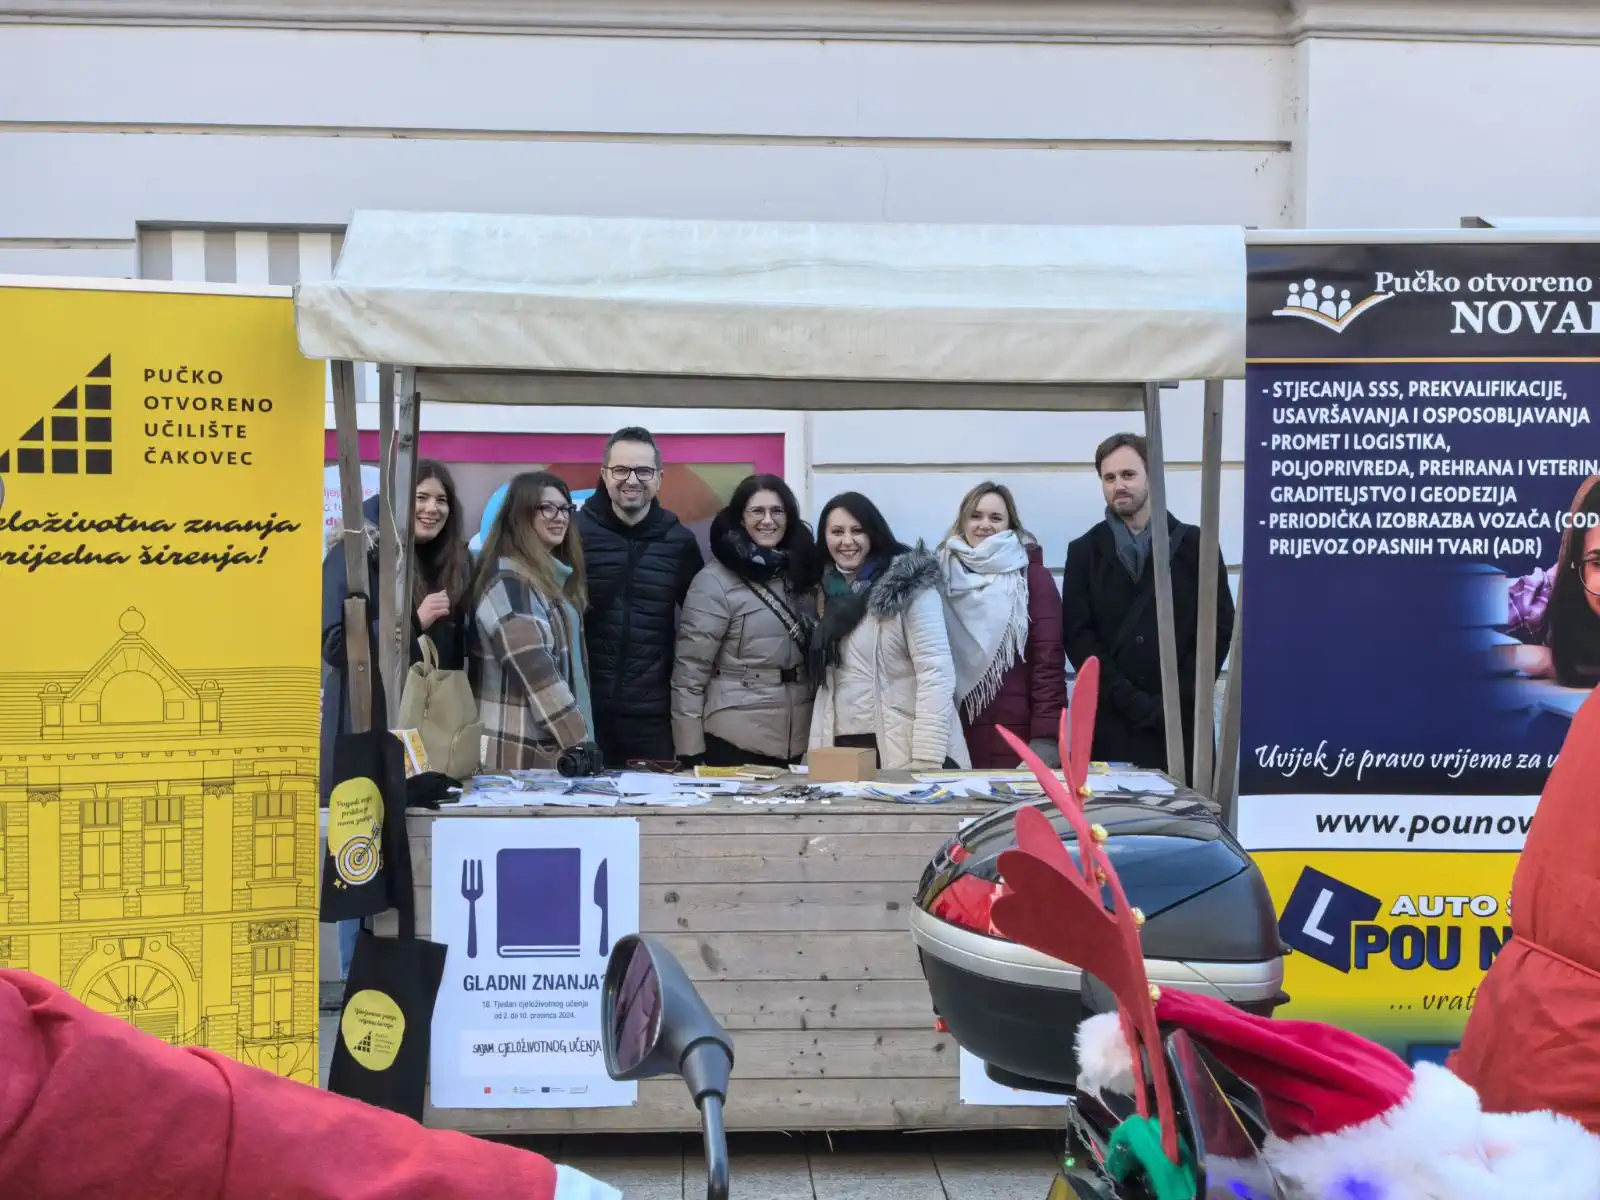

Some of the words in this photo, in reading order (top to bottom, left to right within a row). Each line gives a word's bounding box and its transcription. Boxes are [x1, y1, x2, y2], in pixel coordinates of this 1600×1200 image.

[1375, 270, 1460, 293] Pučko
[1468, 273, 1593, 293] otvoreno
[144, 366, 223, 384] PUČKO
[1273, 381, 1364, 401] STJECANJA
[1368, 381, 1403, 400] SSS,
[1408, 380, 1567, 401] PREKVALIFIKACIJE,
[144, 396, 273, 412] OTVORENO
[1272, 404, 1409, 426] USAVRŠAVANJA
[1422, 407, 1590, 427] OSPOSOBLJAVANJA
[144, 420, 247, 438] UČILIŠTE
[1271, 434, 1341, 450] PROMET
[1353, 433, 1451, 452] LOGISTIKA,
[144, 446, 252, 465] ČAKOVEC
[1271, 460, 1414, 480] POLJOPRIVREDA,
[1419, 460, 1513, 476] PREHRANA
[1527, 459, 1600, 476] VETERIN
[1270, 486, 1406, 506] GRADITELJSTVO
[1420, 486, 1517, 506] GEODEZIJA
[184, 513, 301, 540] znanja
[1269, 509, 1372, 529] PERIODIČKA
[1376, 512, 1475, 529] IZOBRAZBA
[1479, 509, 1551, 528] VOZAČA
[139, 545, 269, 571] širenja!
[1269, 539, 1349, 558] PRIJEVOZ
[1352, 538, 1433, 555] OPASNIH
[1437, 538, 1489, 554] TVARI
[1494, 537, 1542, 559] (ADR)
[1255, 739, 1328, 777] Uvijek
[1323, 748, 1355, 777] je
[1357, 749, 1425, 781] pravo
[1430, 748, 1512, 778] vrijeme
[1516, 753, 1542, 769] za
[1302, 888, 1335, 945] L
[1389, 895, 1498, 917] AUTO
[1354, 924, 1462, 971] POU
[463, 974, 526, 991] GLADNI
[494, 1001, 517, 1009] Tjedan
[565, 1000, 589, 1008] učenja
